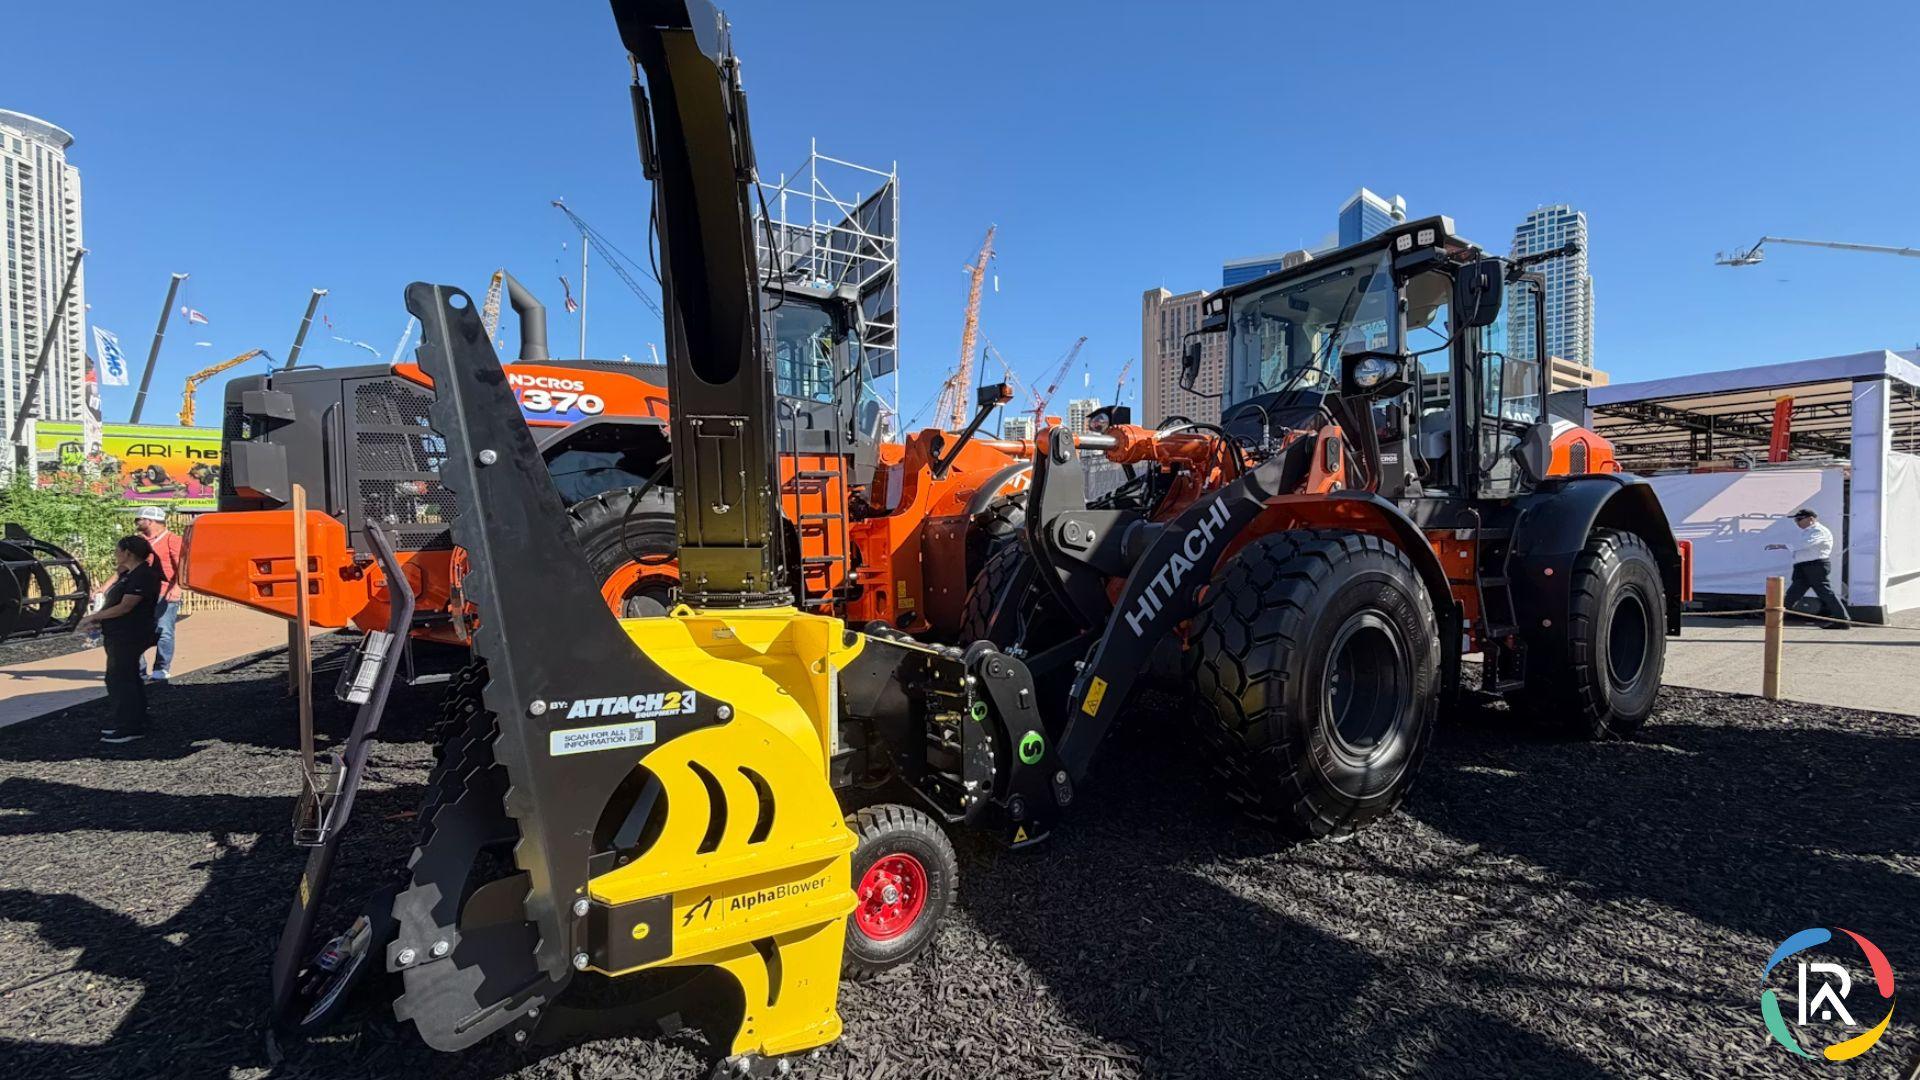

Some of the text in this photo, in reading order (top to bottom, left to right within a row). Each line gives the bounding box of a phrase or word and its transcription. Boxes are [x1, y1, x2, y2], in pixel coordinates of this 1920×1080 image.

[126, 443, 223, 459] ARI-he
[1124, 496, 1232, 637] HITACHI
[550, 701, 568, 710] BY:
[635, 709, 681, 719] EQUIPMENT
[564, 729, 626, 742] SCAN FOR ALL
[564, 736, 627, 748] INFORMATION
[730, 877, 826, 911] AlphaBlower
